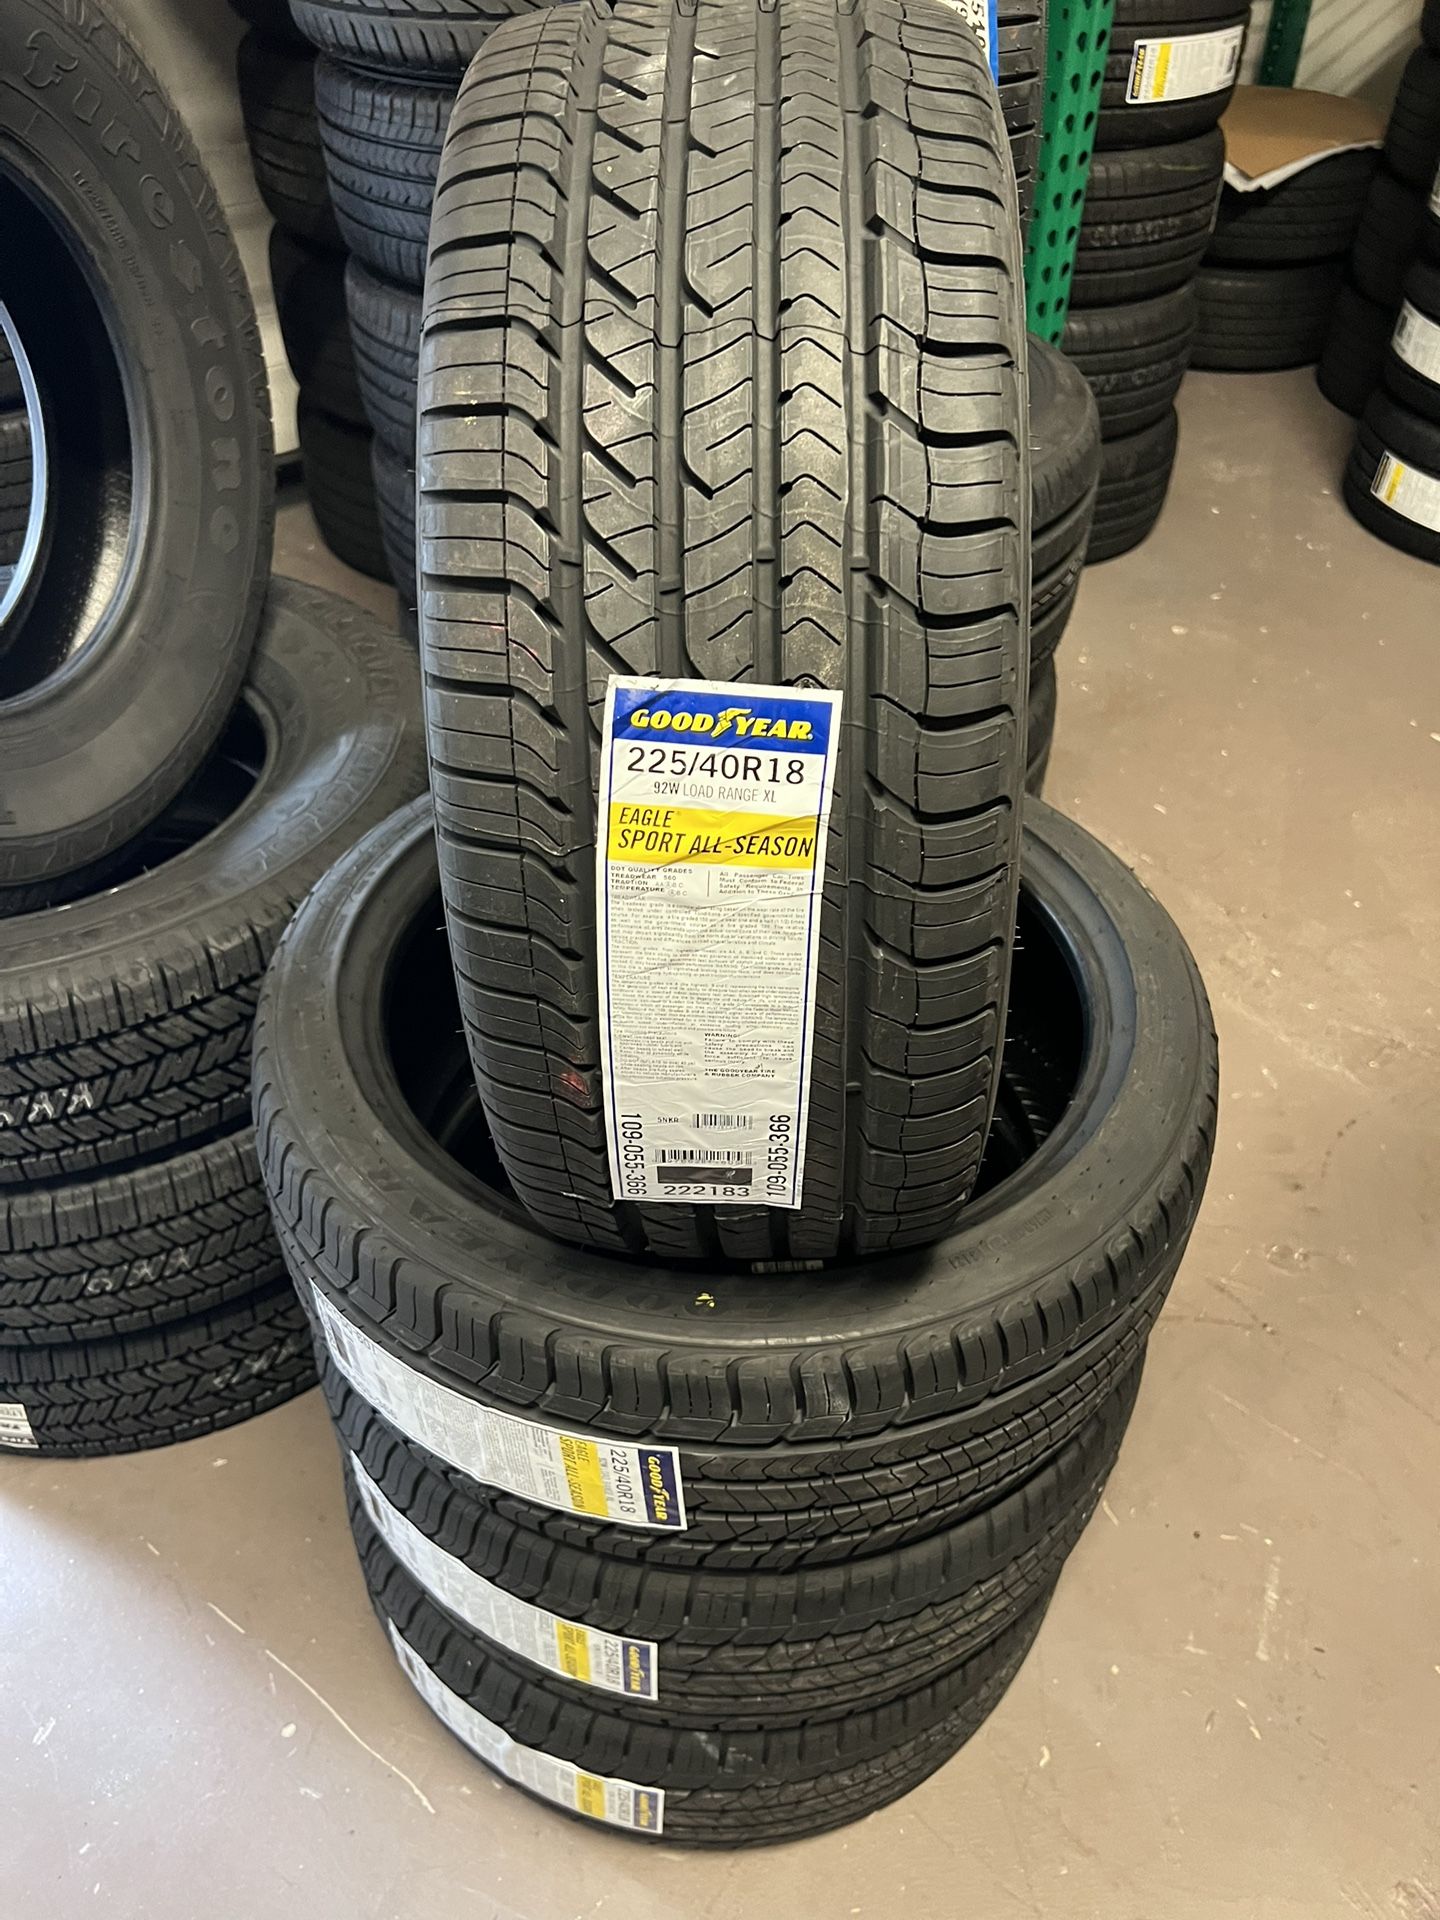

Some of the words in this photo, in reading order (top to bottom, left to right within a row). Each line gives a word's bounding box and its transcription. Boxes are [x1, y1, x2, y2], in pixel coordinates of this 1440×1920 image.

[630, 708, 814, 740] GOODYEAR
[627, 747, 805, 785] 225/40R18
[654, 781, 680, 795] 92W
[682, 783, 714, 799] LOAD
[718, 786, 759, 802] RANGE
[762, 789, 777, 803] XL
[619, 807, 674, 828] EAGLE
[617, 829, 686, 853] SPORT
[689, 834, 814, 857] ALL-SEASON
[611, 872, 657, 880] TREADWEAR
[611, 878, 648, 886] TRACTION
[620, 1113, 647, 1195] 109-055-366
[766, 1114, 791, 1197] 109-055-366
[663, 1185, 750, 1197] 222183
[560, 1436, 580, 1463] SPORT
[574, 1440, 590, 1463] EAGLE
[564, 1463, 586, 1509] ALL-SEASON
[610, 1449, 636, 1514] 225/40R18
[647, 1455, 670, 1521] GOODYEAR
